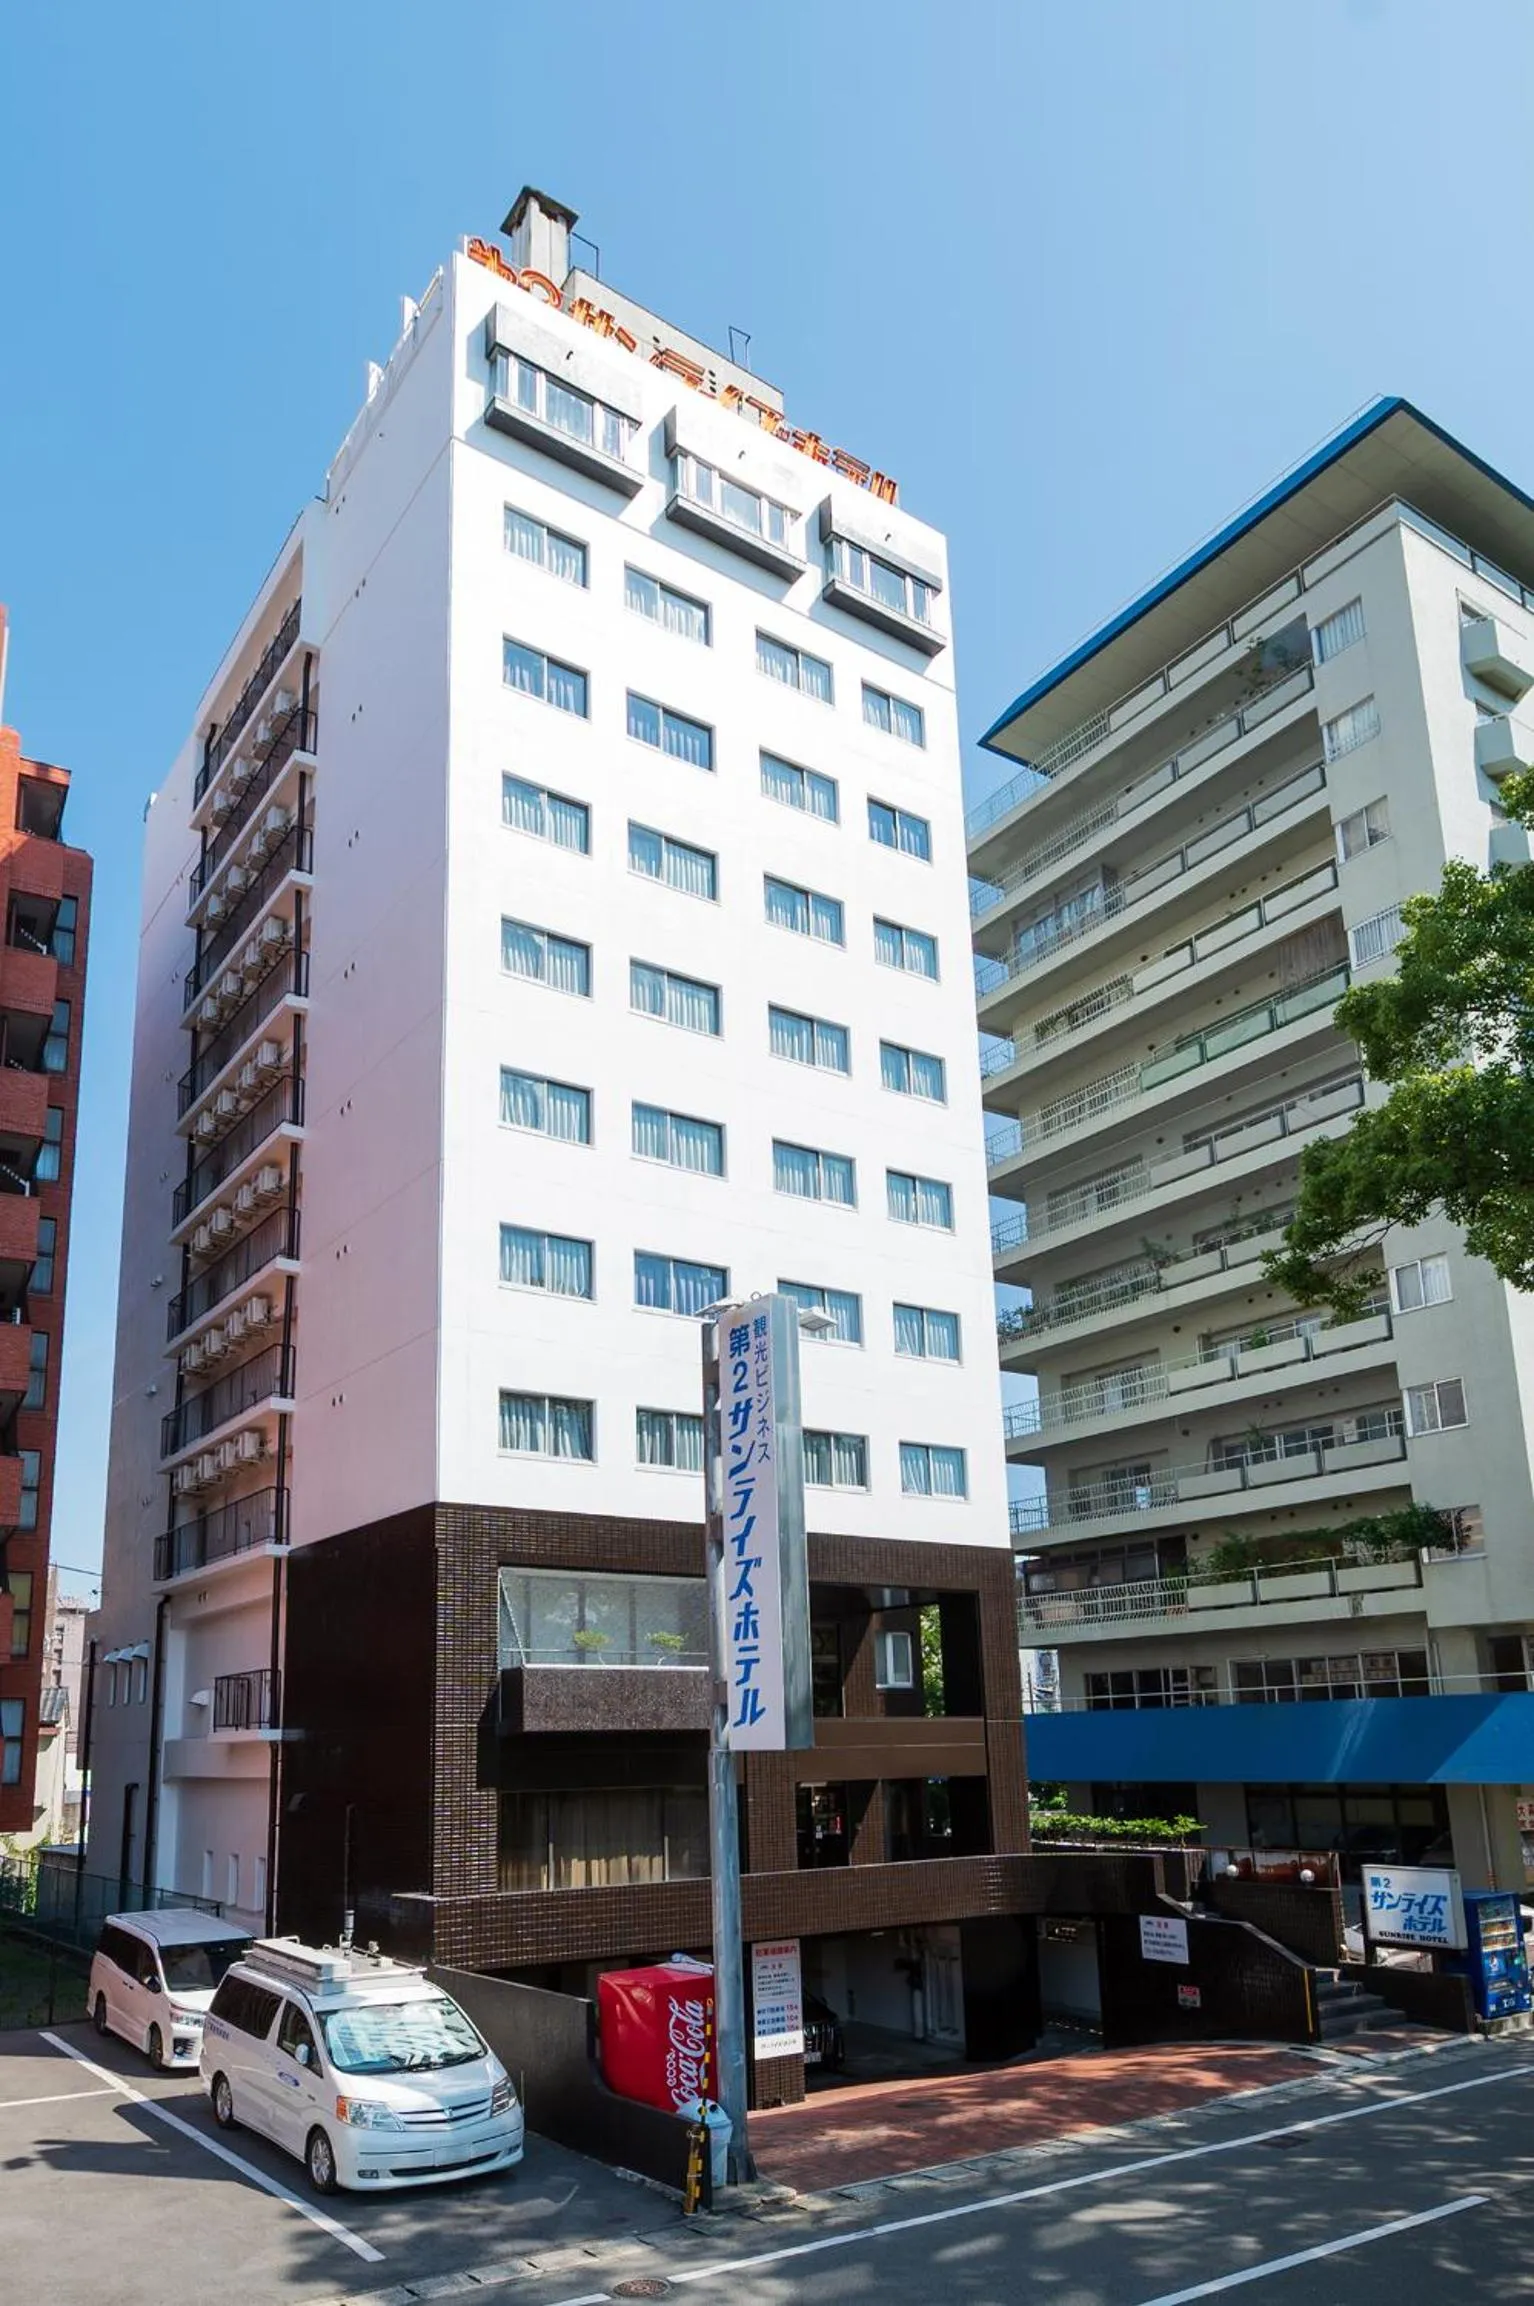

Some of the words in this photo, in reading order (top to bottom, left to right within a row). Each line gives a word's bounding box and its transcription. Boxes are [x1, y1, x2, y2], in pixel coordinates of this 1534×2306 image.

[753, 1315, 771, 1464] 観光ビジネス
[728, 1324, 766, 1728] 第2サンライズホテル
[1370, 1890, 1448, 1916] サンライズ
[1403, 1915, 1447, 1933] ホテル
[1419, 1934, 1449, 1944] HOTEL
